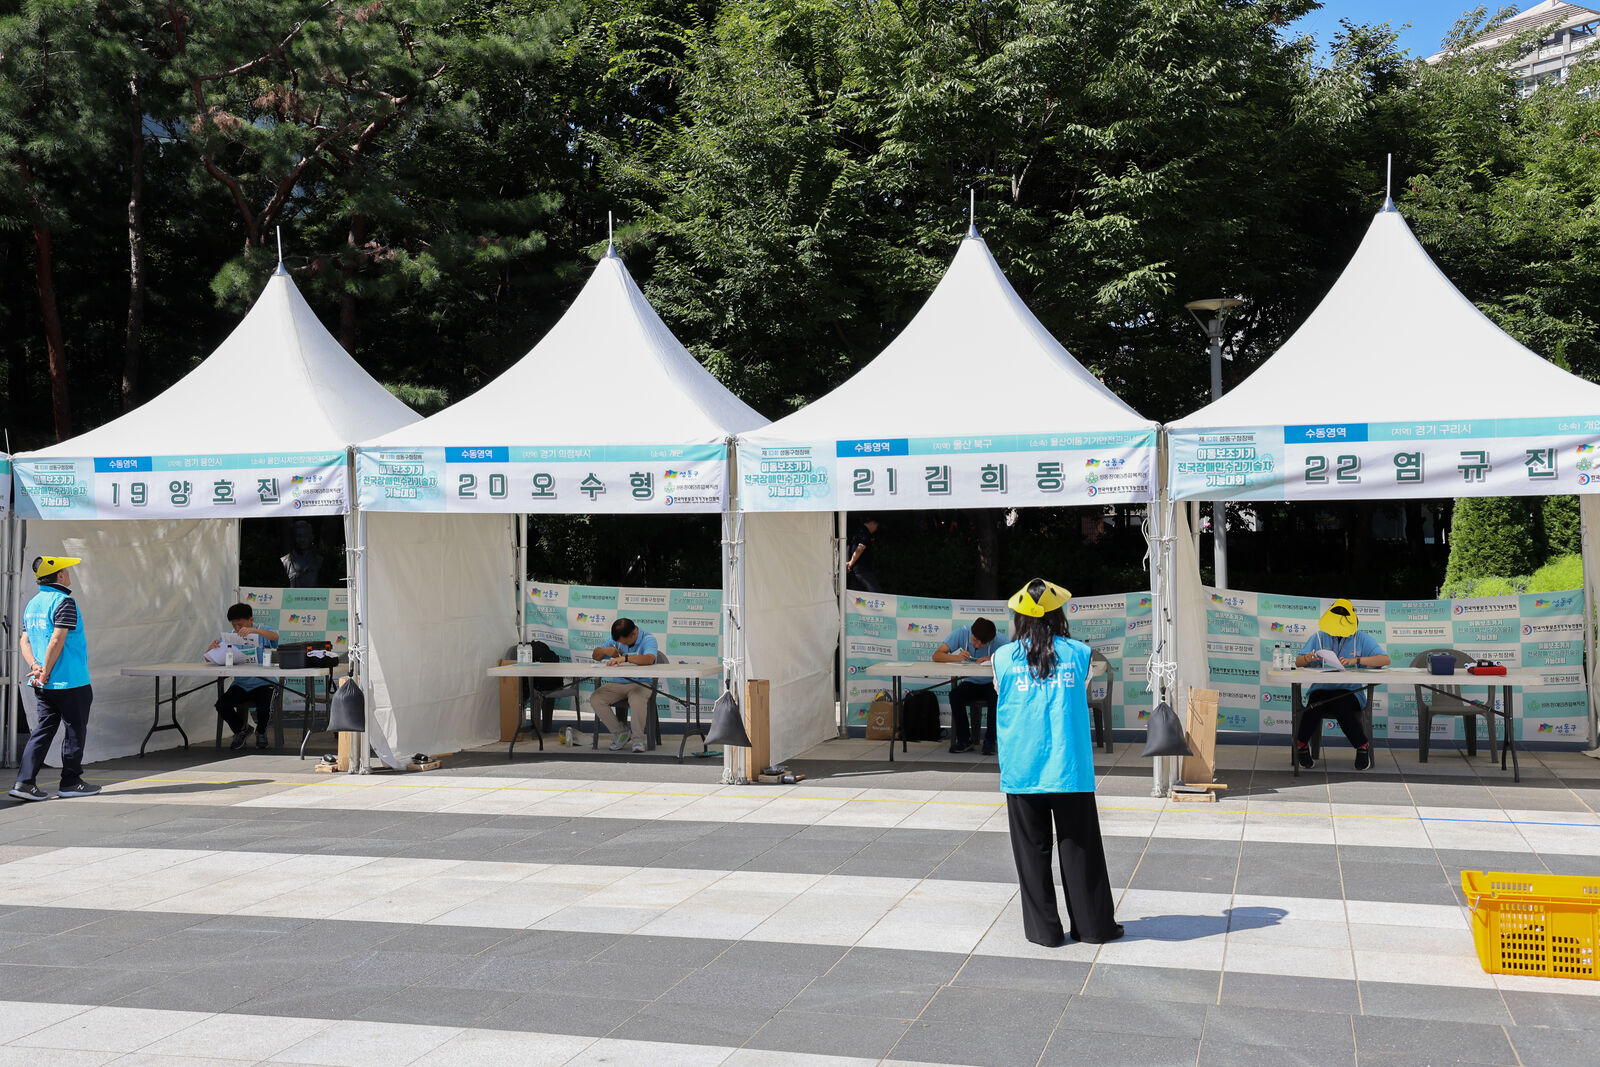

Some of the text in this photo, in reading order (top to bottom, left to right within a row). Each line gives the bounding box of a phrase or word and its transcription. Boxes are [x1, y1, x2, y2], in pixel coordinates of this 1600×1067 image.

[1305, 427, 1347, 438] 수동영역
[1415, 425, 1437, 436] 경기
[1439, 423, 1472, 434] 구리시
[854, 441, 891, 453] 수동영역
[953, 439, 972, 450] 울산
[974, 438, 993, 449] 북구
[461, 449, 493, 459] 수동영역
[541, 449, 557, 458] 경기
[558, 448, 591, 459] 의정부시
[1197, 447, 1256, 461] 이동보조기기
[109, 459, 138, 468] 수동영역
[184, 458, 199, 467] 경기
[760, 460, 812, 473] 이동보조기기
[1102, 458, 1125, 467] 성동구
[1177, 460, 1275, 474] 전국장애인수리기술자
[679, 469, 699, 478] 성동구
[1304, 454, 1362, 486] 22
[363, 476, 437, 487] 전국장애인수리기술자
[744, 473, 828, 486] 전국장애인수리기술자
[853, 468, 898, 496] 21
[1206, 474, 1247, 487] 기능대회
[20, 486, 88, 497] 전국장애인수리기술자
[458, 473, 509, 500] 20
[768, 485, 805, 498] 기능대회
[111, 482, 149, 506] 19
[385, 488, 418, 498] 기능대회
[41, 497, 71, 507] 기능대회
[258, 593, 273, 601] 성동구
[542, 589, 559, 598] 성동구
[867, 600, 886, 609] 성동구
[1224, 597, 1244, 606] 성동구
[1552, 598, 1573, 608] 성동구
[301, 614, 317, 623] 성동구
[588, 614, 606, 623] 성동구
[920, 624, 940, 633] 성동구
[1286, 624, 1306, 633] 성동구
[1227, 714, 1248, 725] 성동구
[1555, 724, 1577, 734] 성동구
